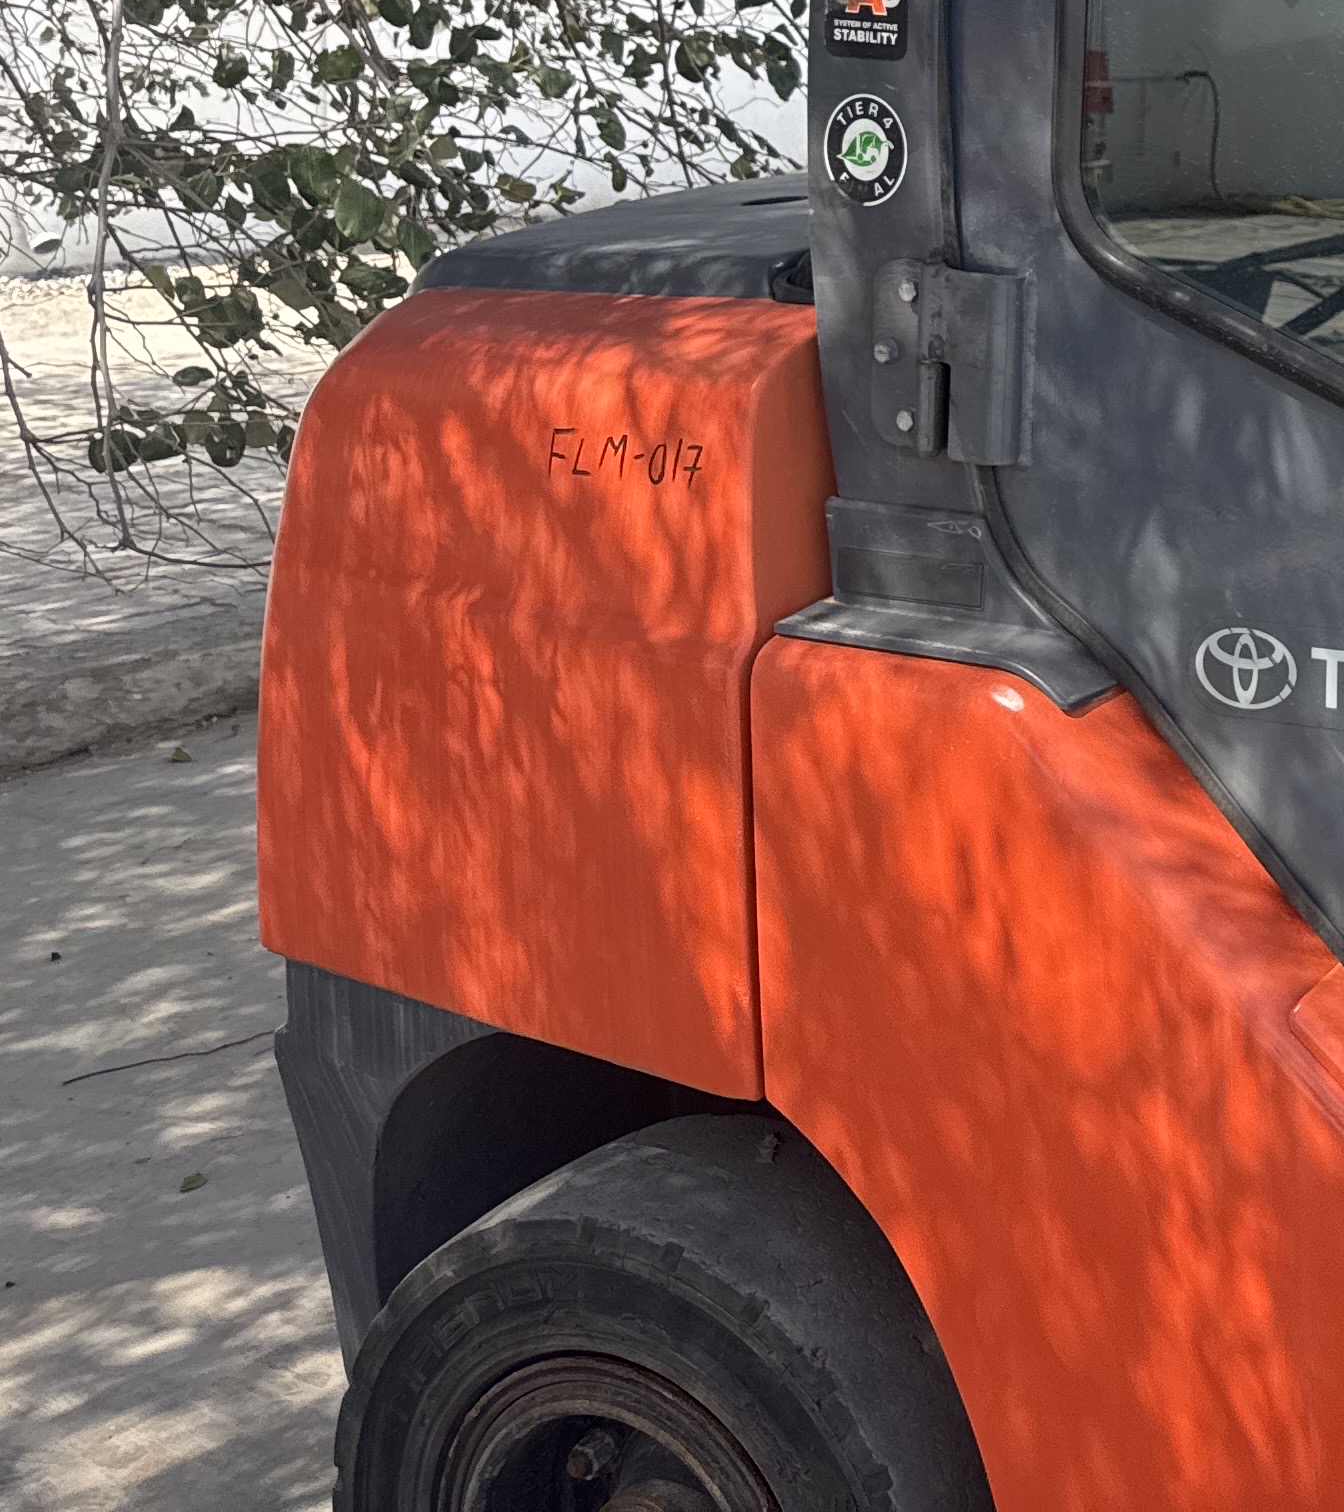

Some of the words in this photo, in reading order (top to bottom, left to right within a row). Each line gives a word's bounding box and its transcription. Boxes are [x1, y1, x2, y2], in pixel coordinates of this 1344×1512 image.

[833, 28, 899, 46] STABILITY
[834, 19, 861, 28] SYSTEM
[862, 21, 872, 29] OF
[873, 22, 898, 31] ACTIVE
[837, 101, 879, 126] TIER
[883, 116, 895, 129] 4
[840, 172, 895, 197] FAL
[549, 428, 704, 489] FLM-017
